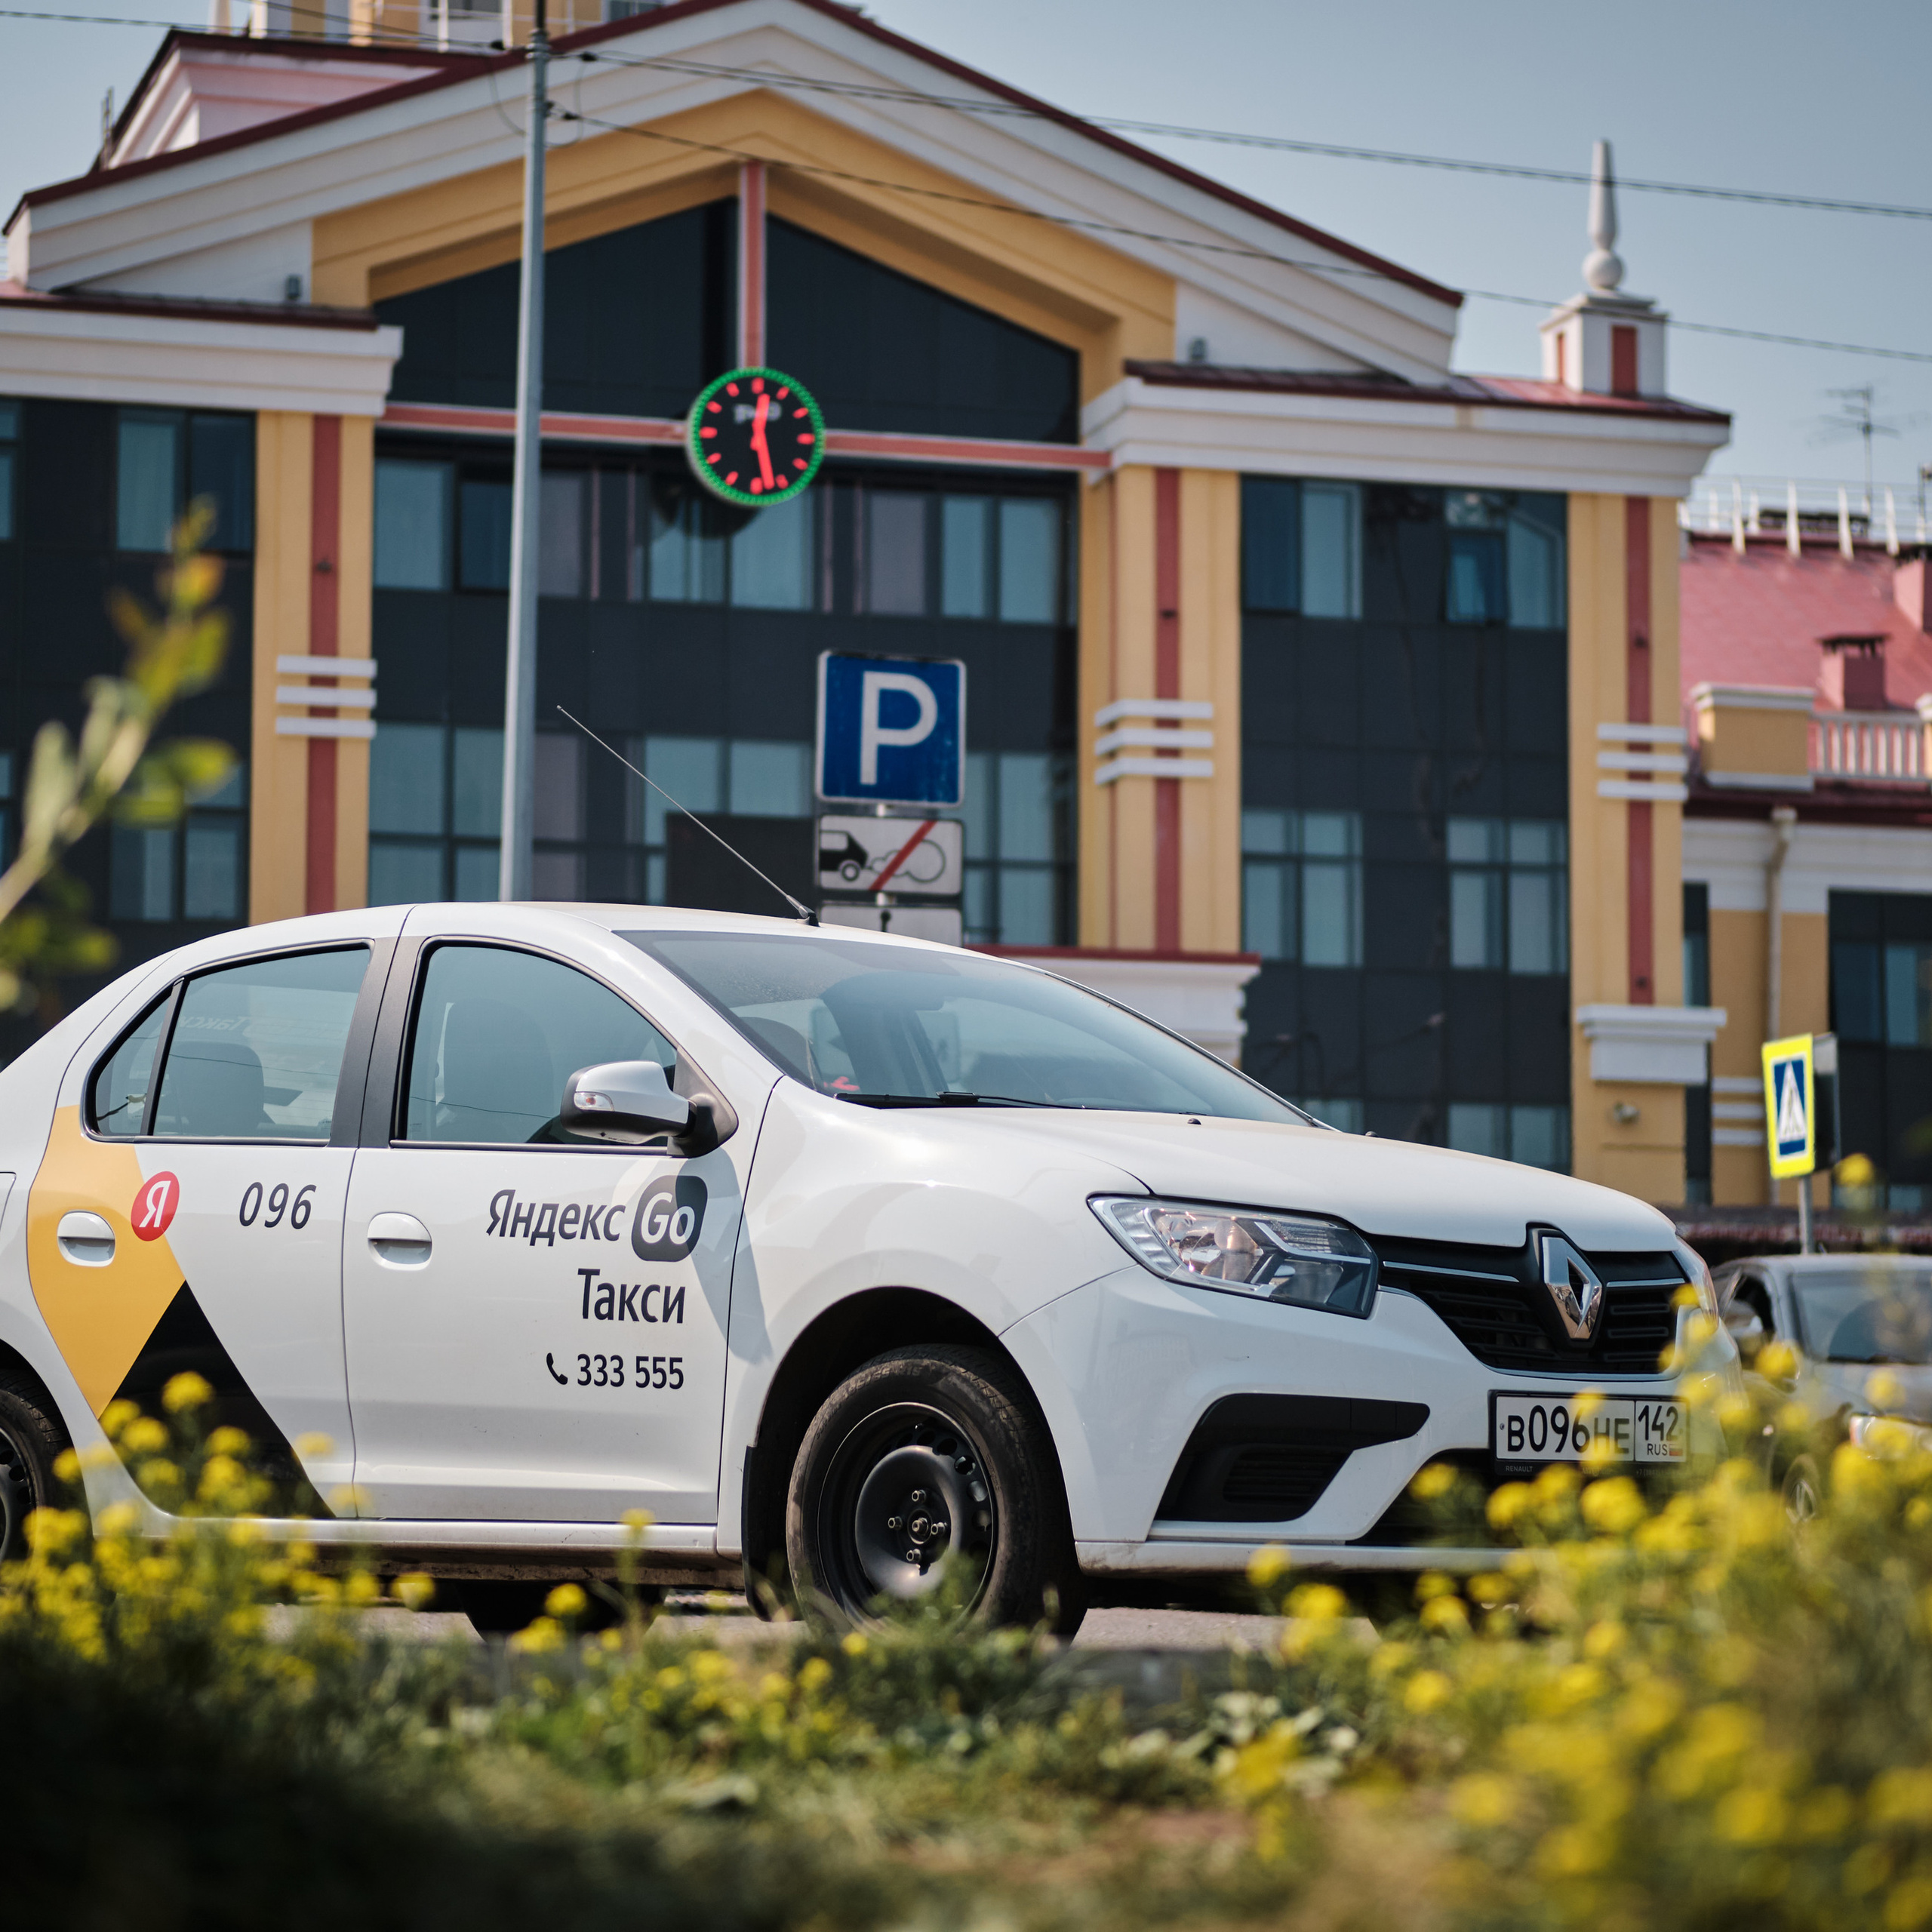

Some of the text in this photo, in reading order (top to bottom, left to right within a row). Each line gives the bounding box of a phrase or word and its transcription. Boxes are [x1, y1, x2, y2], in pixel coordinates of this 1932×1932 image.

[860, 671, 938, 786] P
[139, 1180, 171, 1228] Я
[238, 1182, 317, 1229] 096
[486, 1189, 696, 1247] Яндекс Go
[577, 1268, 686, 1324] Такси
[577, 1353, 685, 1389] 333 555
[1638, 1405, 1678, 1441] 142
[1647, 1443, 1668, 1456] RUS
